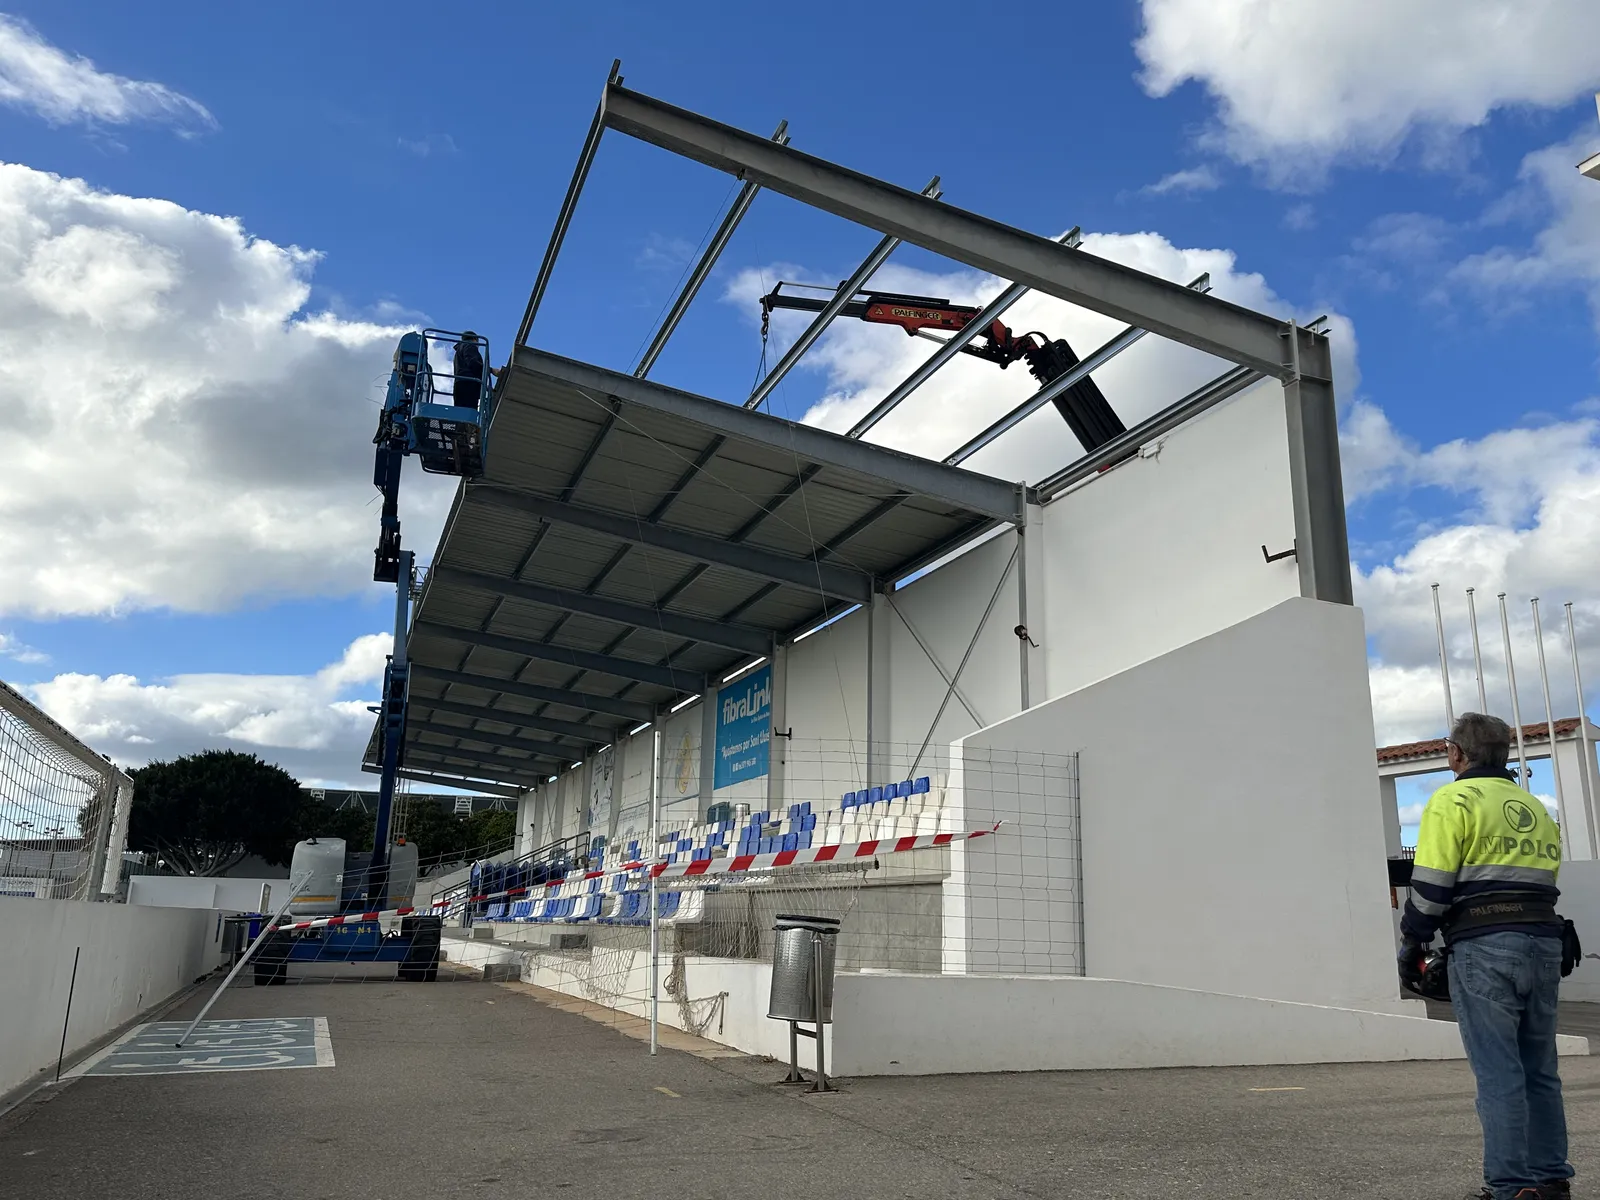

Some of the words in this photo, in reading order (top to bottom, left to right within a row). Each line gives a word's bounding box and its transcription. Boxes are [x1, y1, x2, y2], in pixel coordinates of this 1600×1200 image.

[893, 308, 940, 320] PALFINGER
[722, 676, 771, 725] fibraLink
[1469, 902, 1524, 917] PALFINGER
